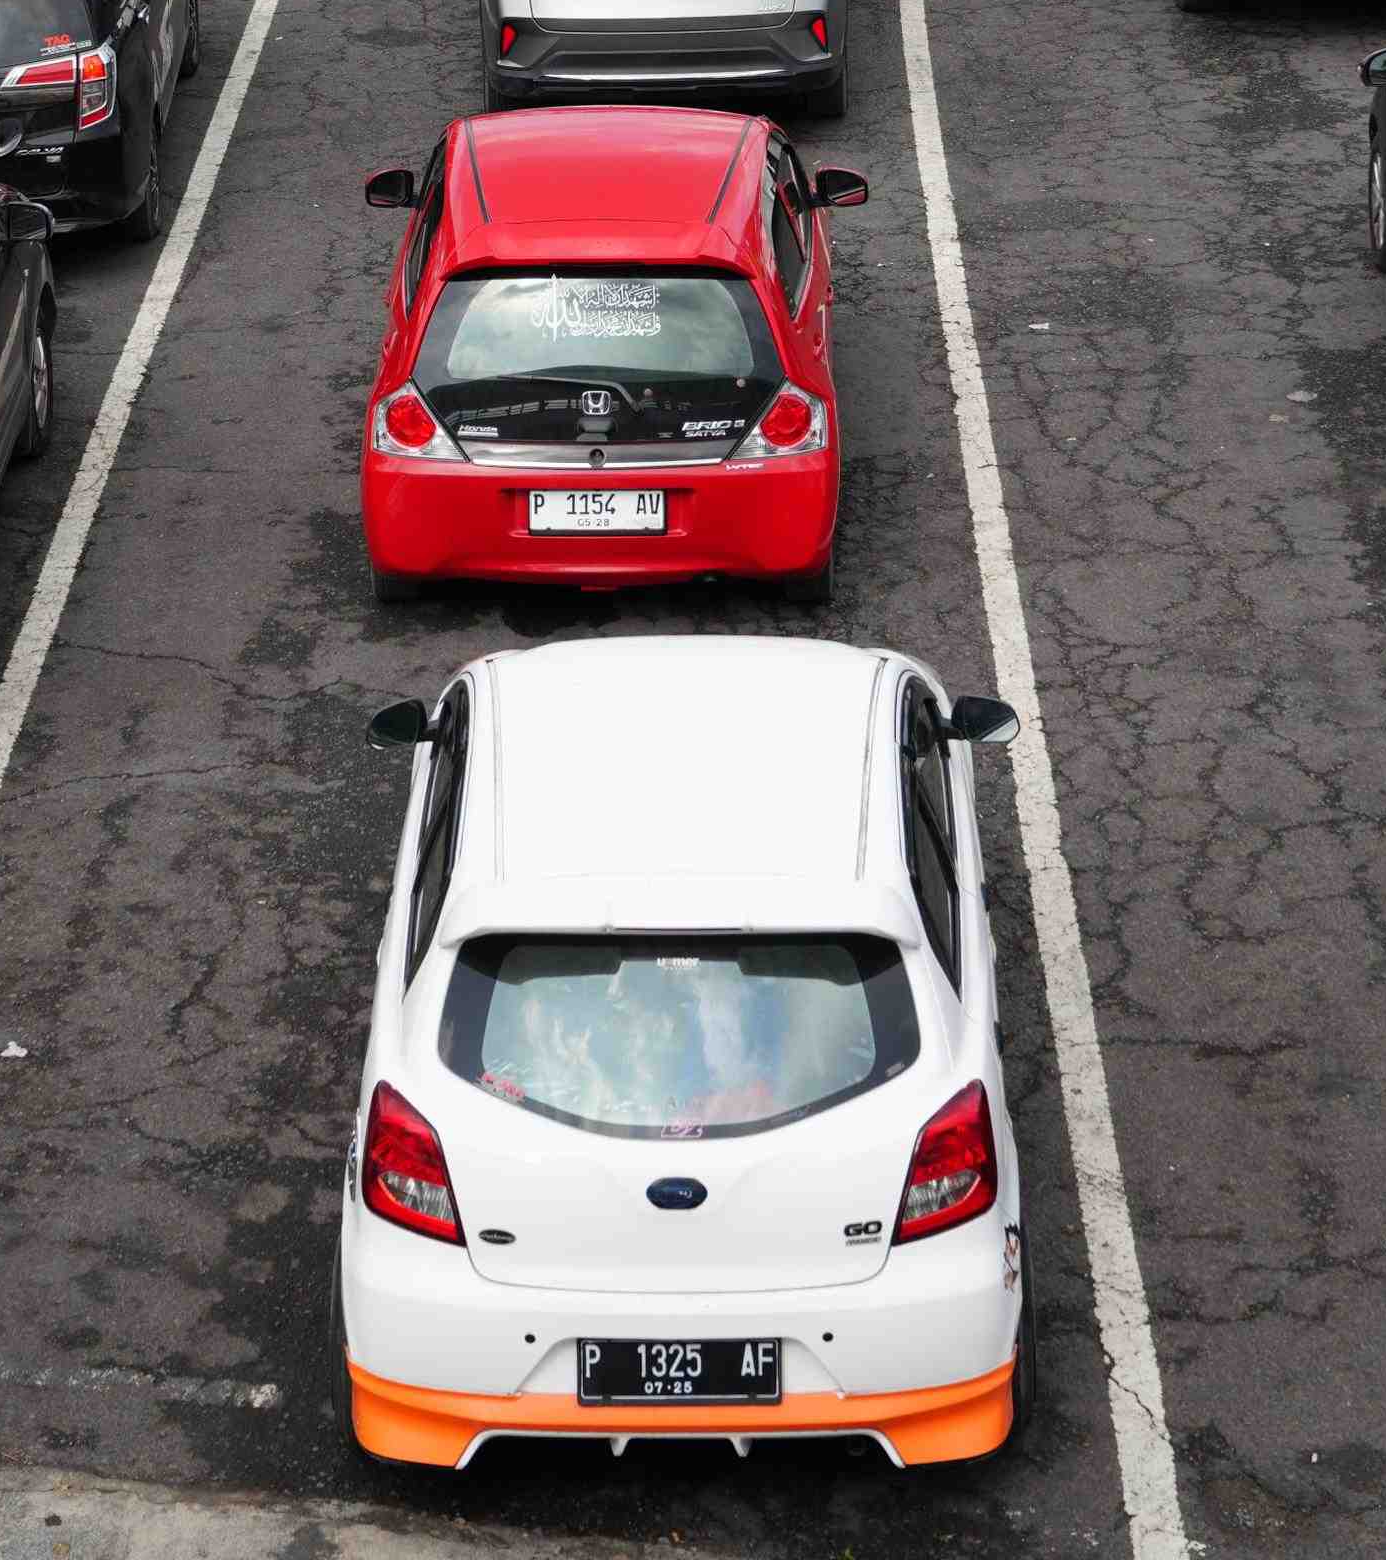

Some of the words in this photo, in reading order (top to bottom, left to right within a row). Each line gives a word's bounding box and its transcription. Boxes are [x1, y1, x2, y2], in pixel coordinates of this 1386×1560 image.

[682, 420, 733, 432] BRIO
[685, 430, 726, 438] SATYA
[534, 494, 545, 515] P
[566, 494, 616, 515] 1154
[636, 494, 661, 514] AV
[844, 1220, 882, 1237] GO
[585, 1344, 601, 1378] P
[637, 1343, 703, 1378] 1325
[740, 1342, 775, 1376] AF
